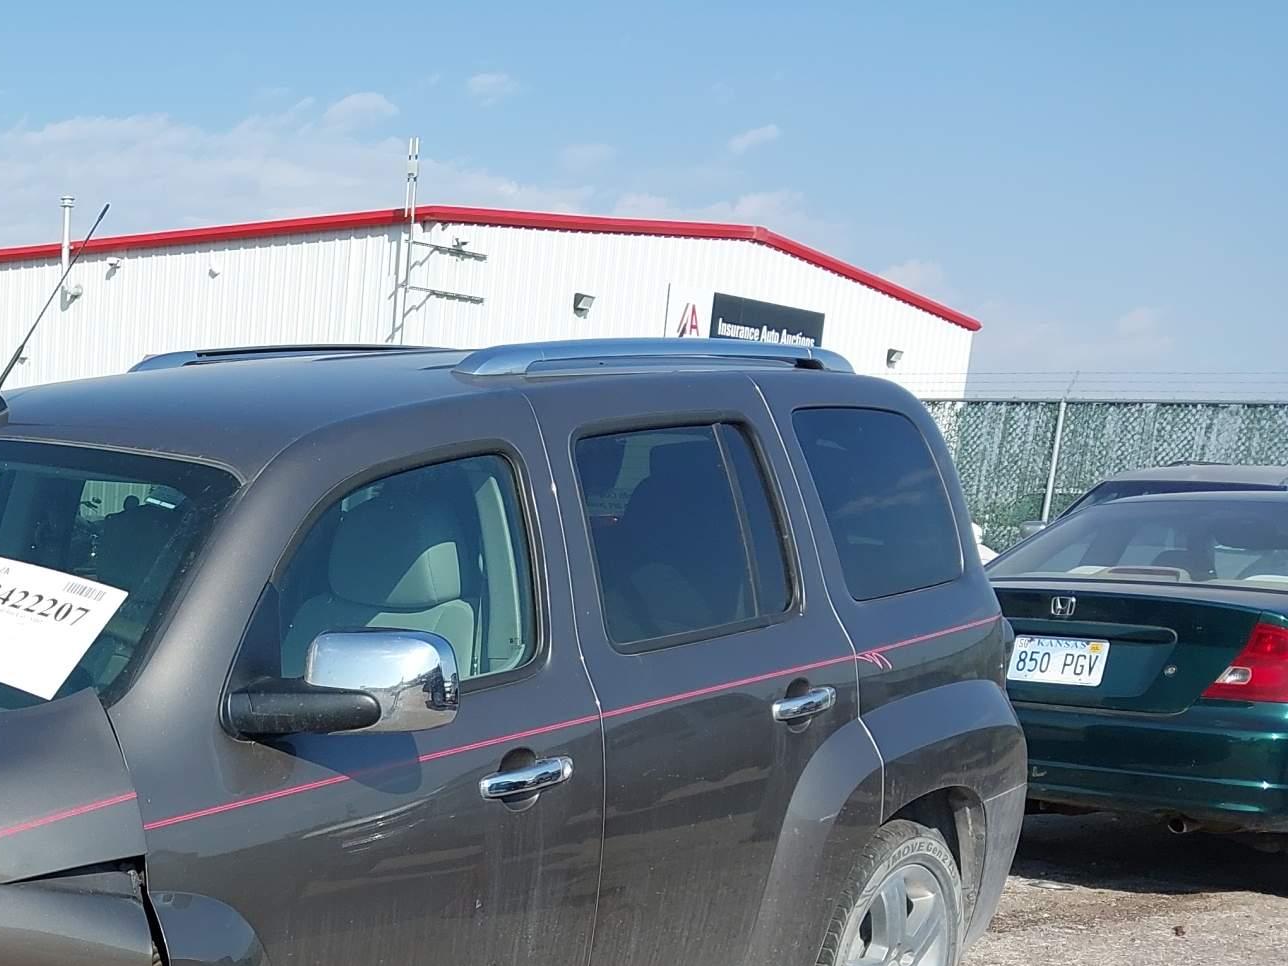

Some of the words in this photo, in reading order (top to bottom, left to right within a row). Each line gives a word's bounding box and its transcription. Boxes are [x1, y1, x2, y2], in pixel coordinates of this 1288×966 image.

[717, 317, 760, 342] Insurance
[760, 325, 780, 344] Auto
[779, 328, 816, 348] Auctions
[1037, 639, 1087, 650] KANSAS
[1016, 650, 1051, 673] 850
[1061, 653, 1099, 676] PGV
[926, 842, 943, 858] Gen
